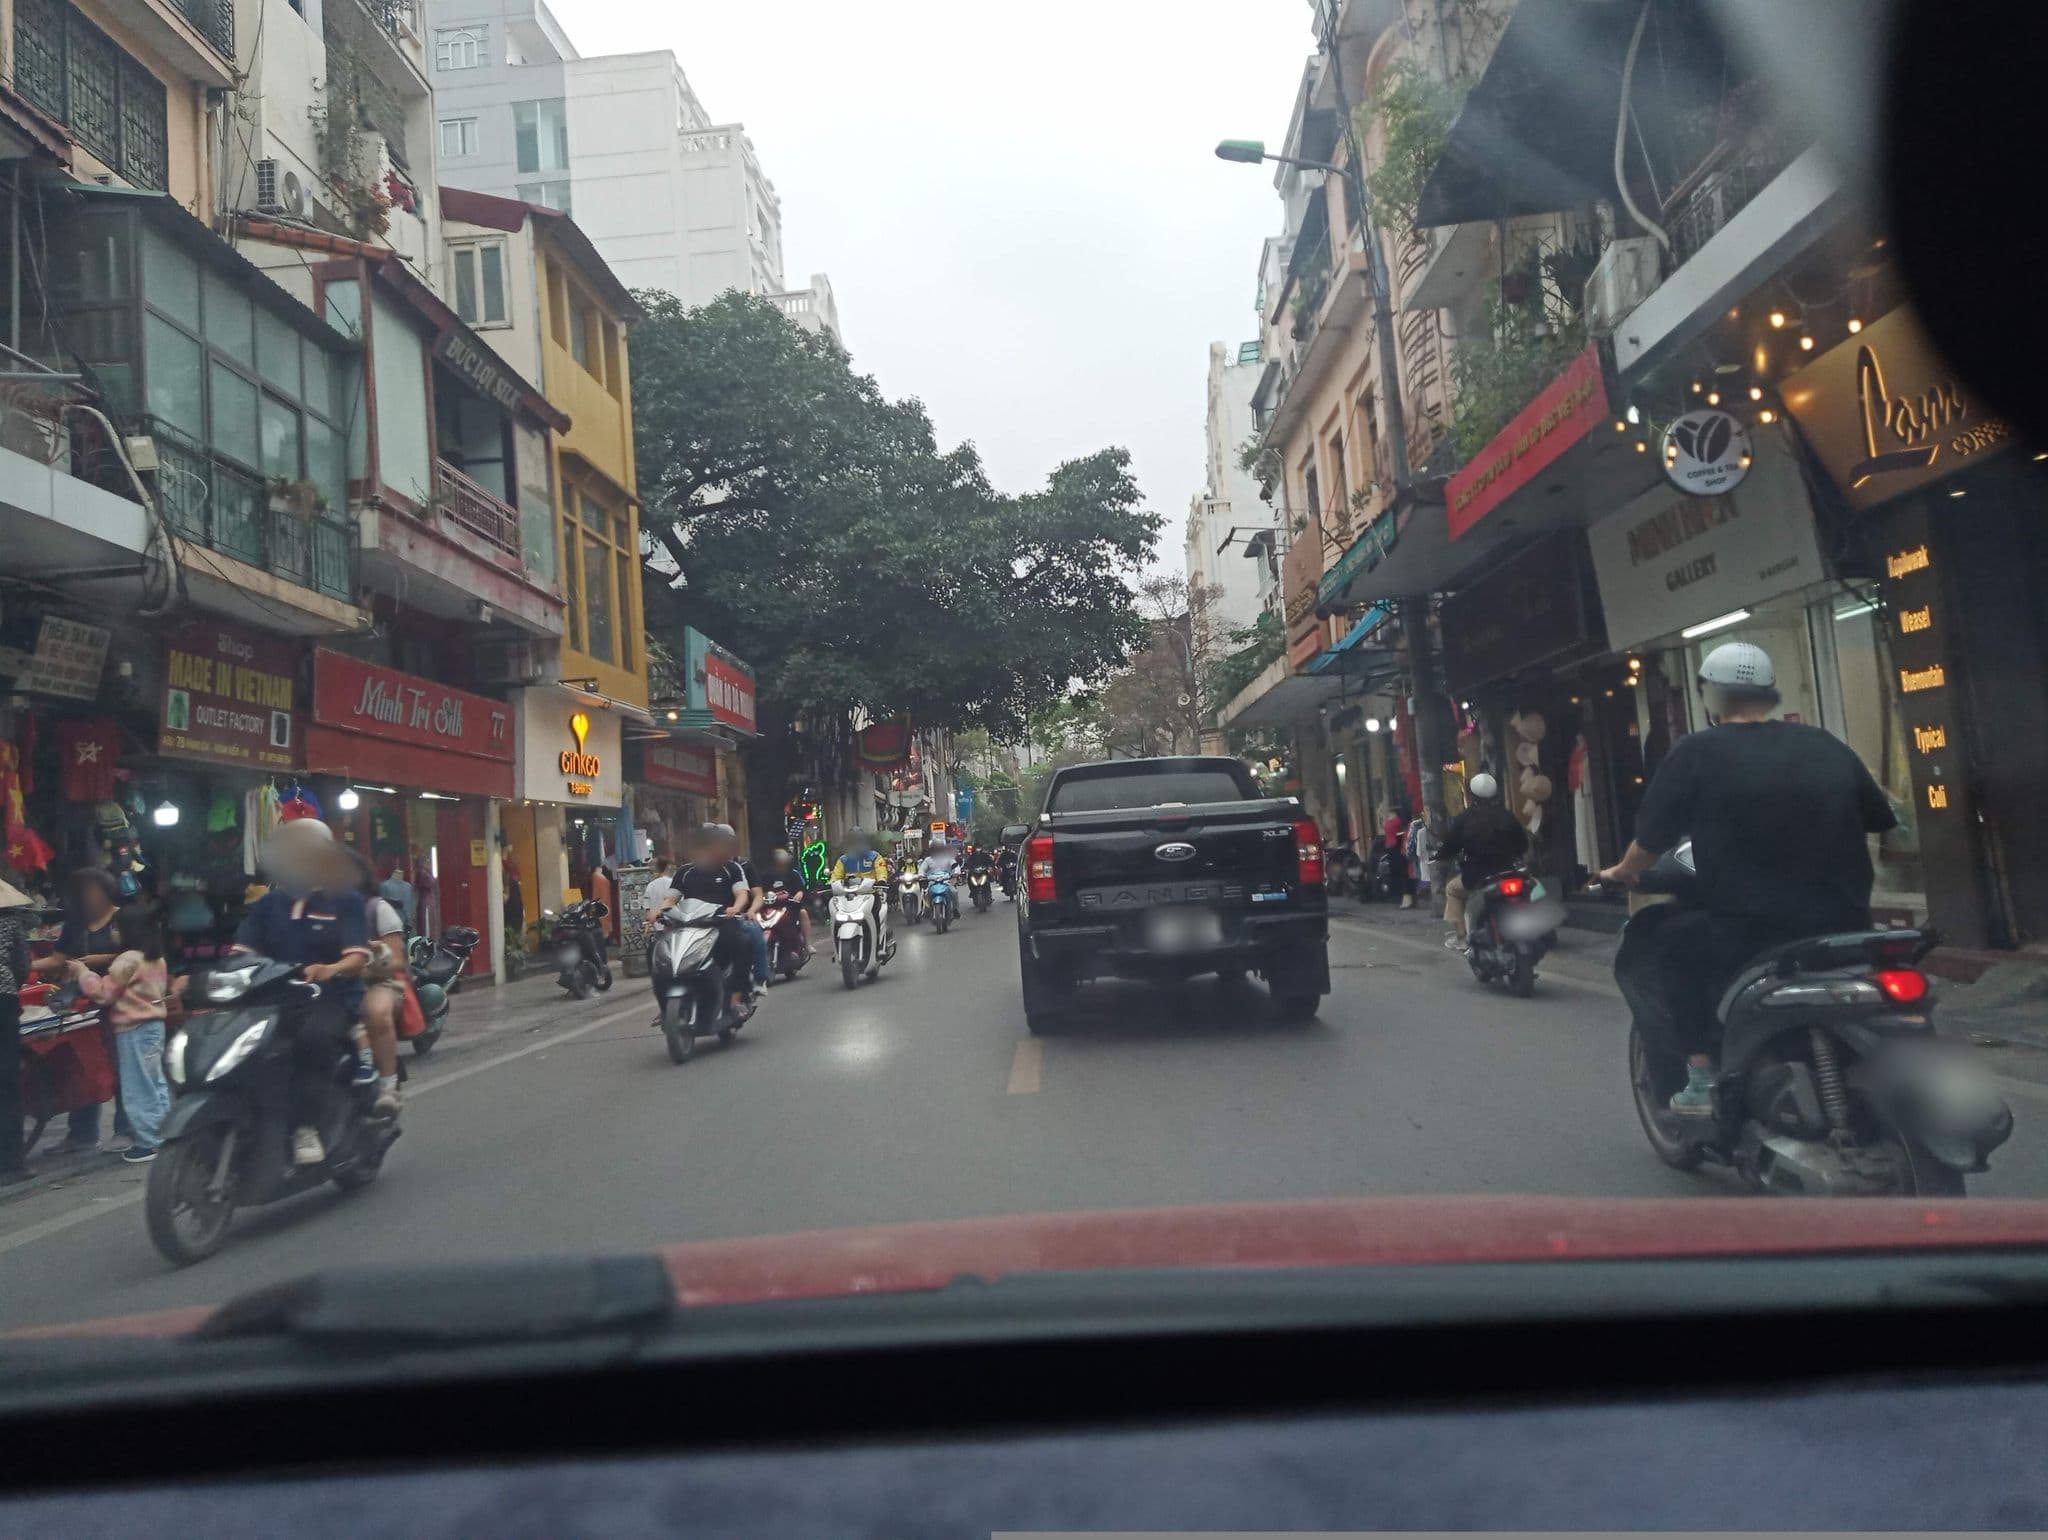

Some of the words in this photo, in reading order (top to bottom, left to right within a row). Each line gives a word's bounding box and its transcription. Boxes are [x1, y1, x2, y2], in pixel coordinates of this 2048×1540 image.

[1687, 467, 1715, 479] COFFEE
[1705, 477, 1727, 487] SHOP
[1666, 552, 1717, 592] GALLERY
[1899, 605, 1931, 634] Weasel
[217, 633, 254, 662] Shop
[168, 649, 213, 694] MADE
[216, 661, 232, 697] IN
[235, 664, 293, 711] VIETNAM
[196, 705, 229, 728] OUTLET
[229, 711, 265, 735] FACTORY
[353, 677, 403, 725] Minh
[434, 697, 464, 736] Silk
[492, 711, 506, 739] 77
